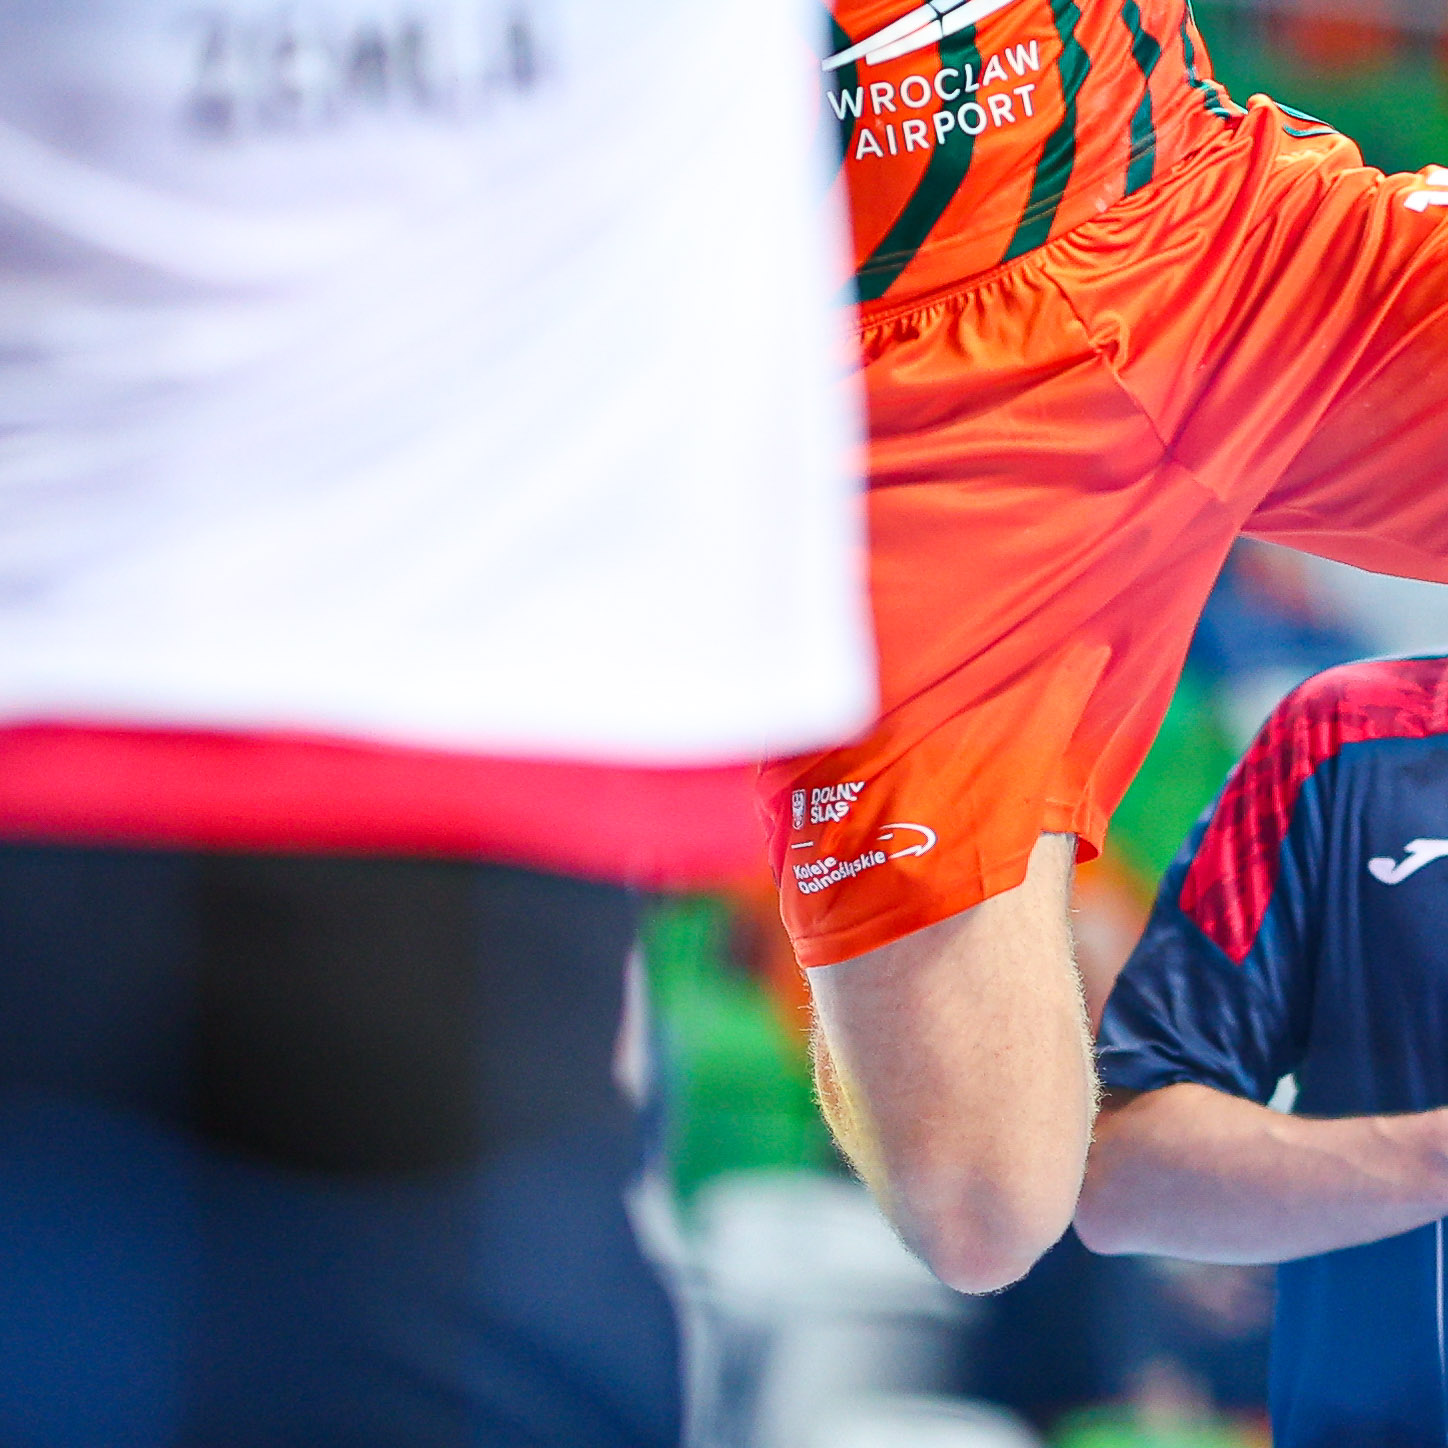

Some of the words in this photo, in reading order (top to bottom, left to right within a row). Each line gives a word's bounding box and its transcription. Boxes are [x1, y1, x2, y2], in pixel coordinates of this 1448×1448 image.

[825, 39, 1041, 121] WROCLAW
[854, 83, 1036, 161] AIRPORT
[809, 800, 851, 825] ŚLĄS
[810, 780, 866, 806] DOLNY
